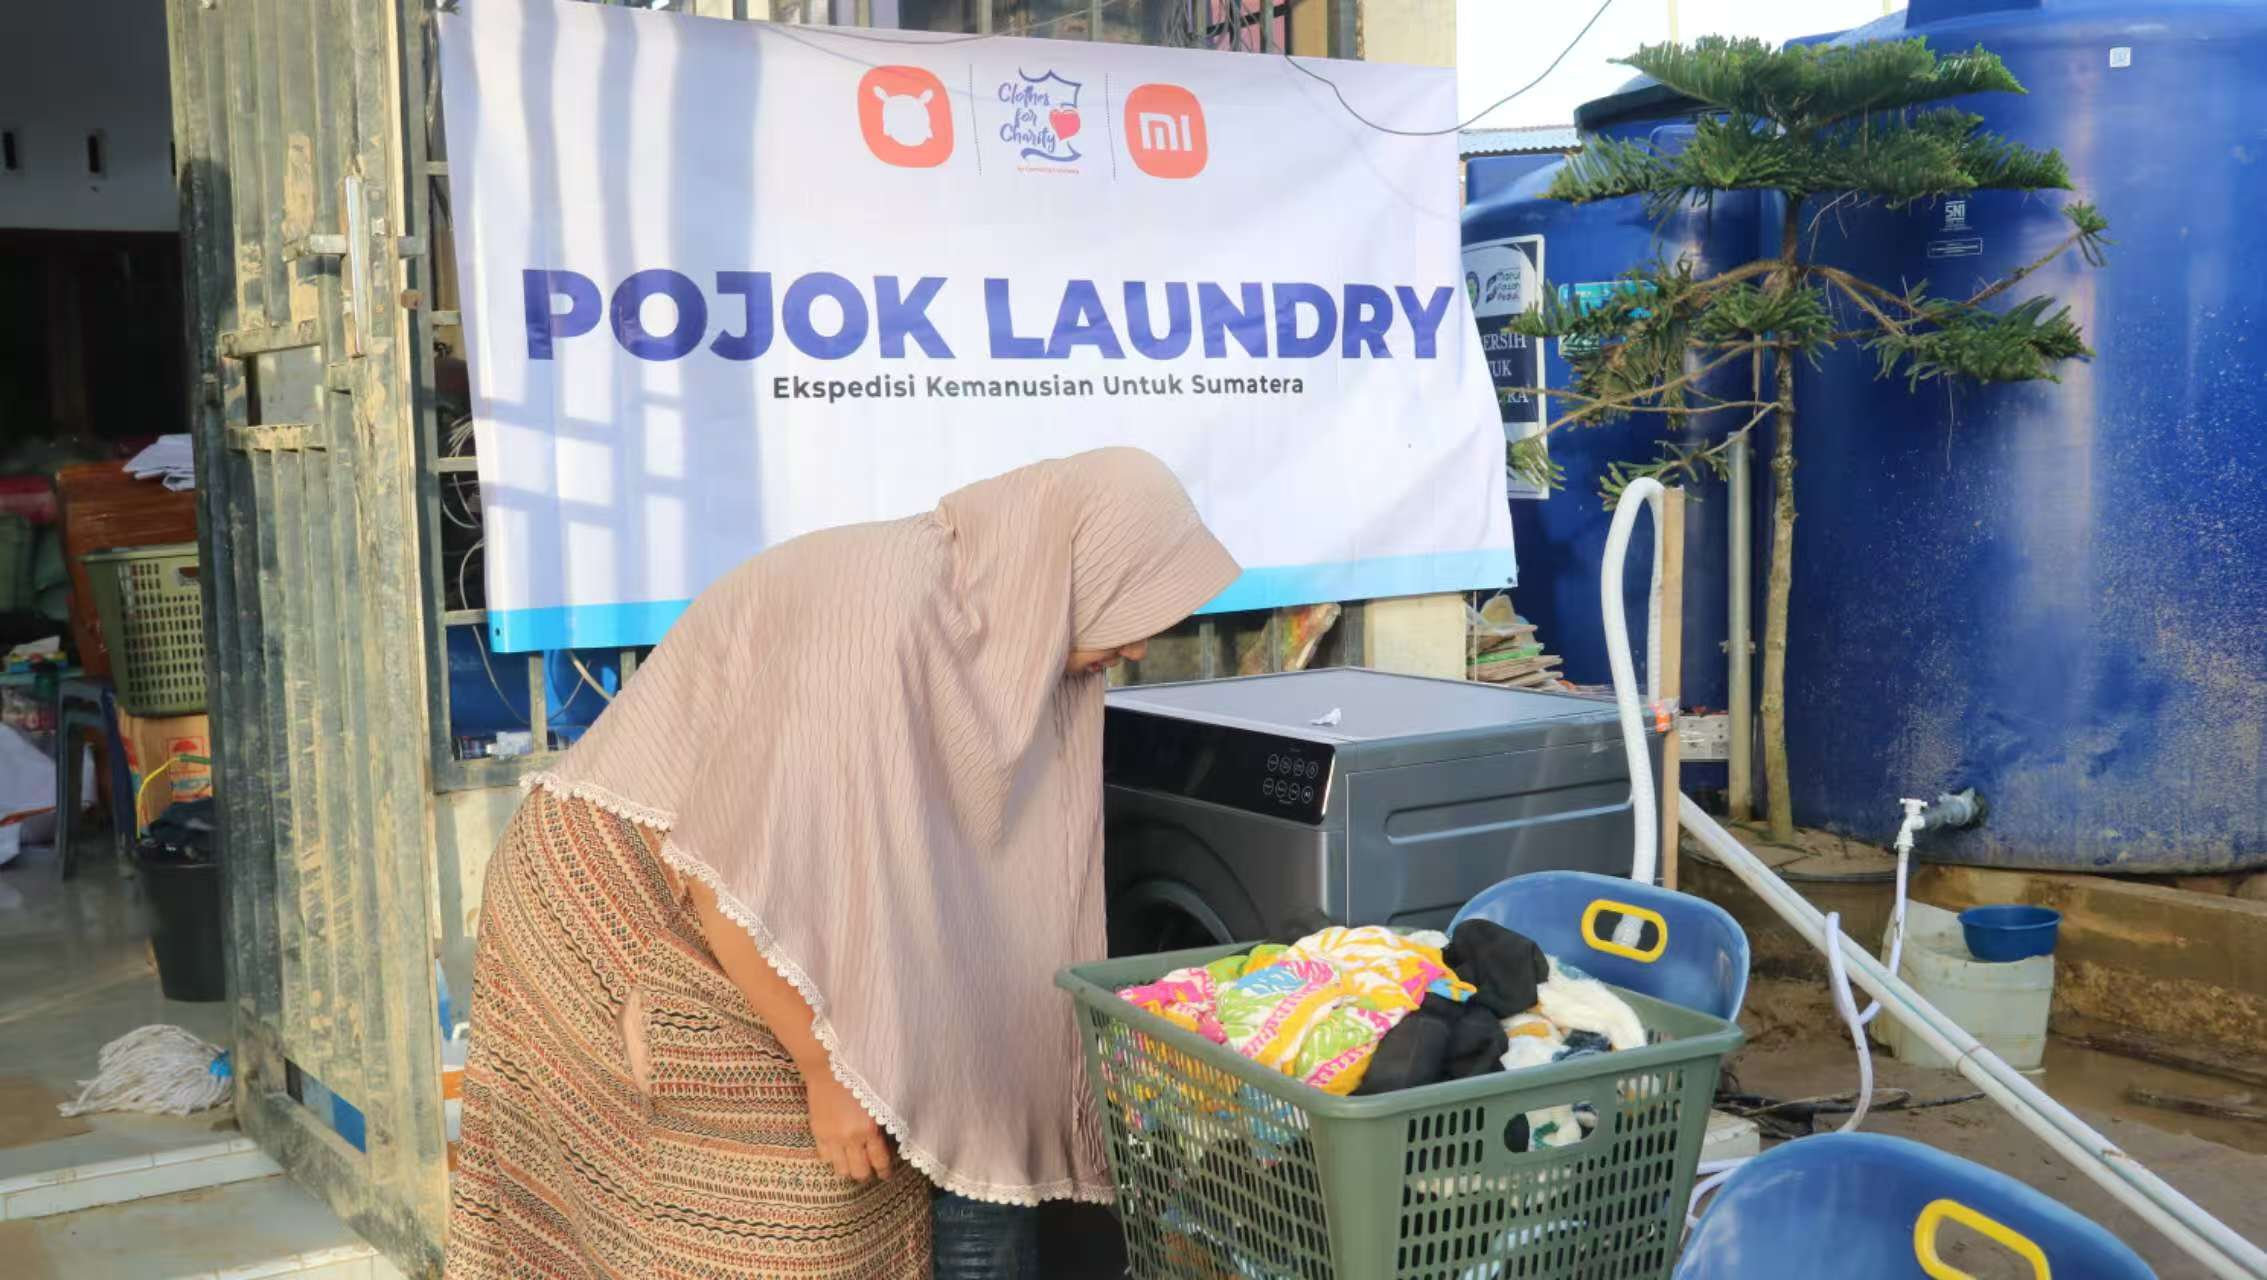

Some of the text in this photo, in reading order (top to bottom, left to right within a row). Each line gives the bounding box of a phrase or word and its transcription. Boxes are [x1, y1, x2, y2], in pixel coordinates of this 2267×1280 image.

[998, 82, 1050, 107] Clothes
[1014, 107, 1037, 128] for
[1000, 123, 1055, 153] Charity
[1945, 204, 1965, 218] SNI
[522, 269, 1454, 362] POJOK LAUNDRY
[1482, 332, 1527, 351] ERSIH
[773, 373, 1304, 404] Ekspedisi Kemanusian Untuk Sumatera
